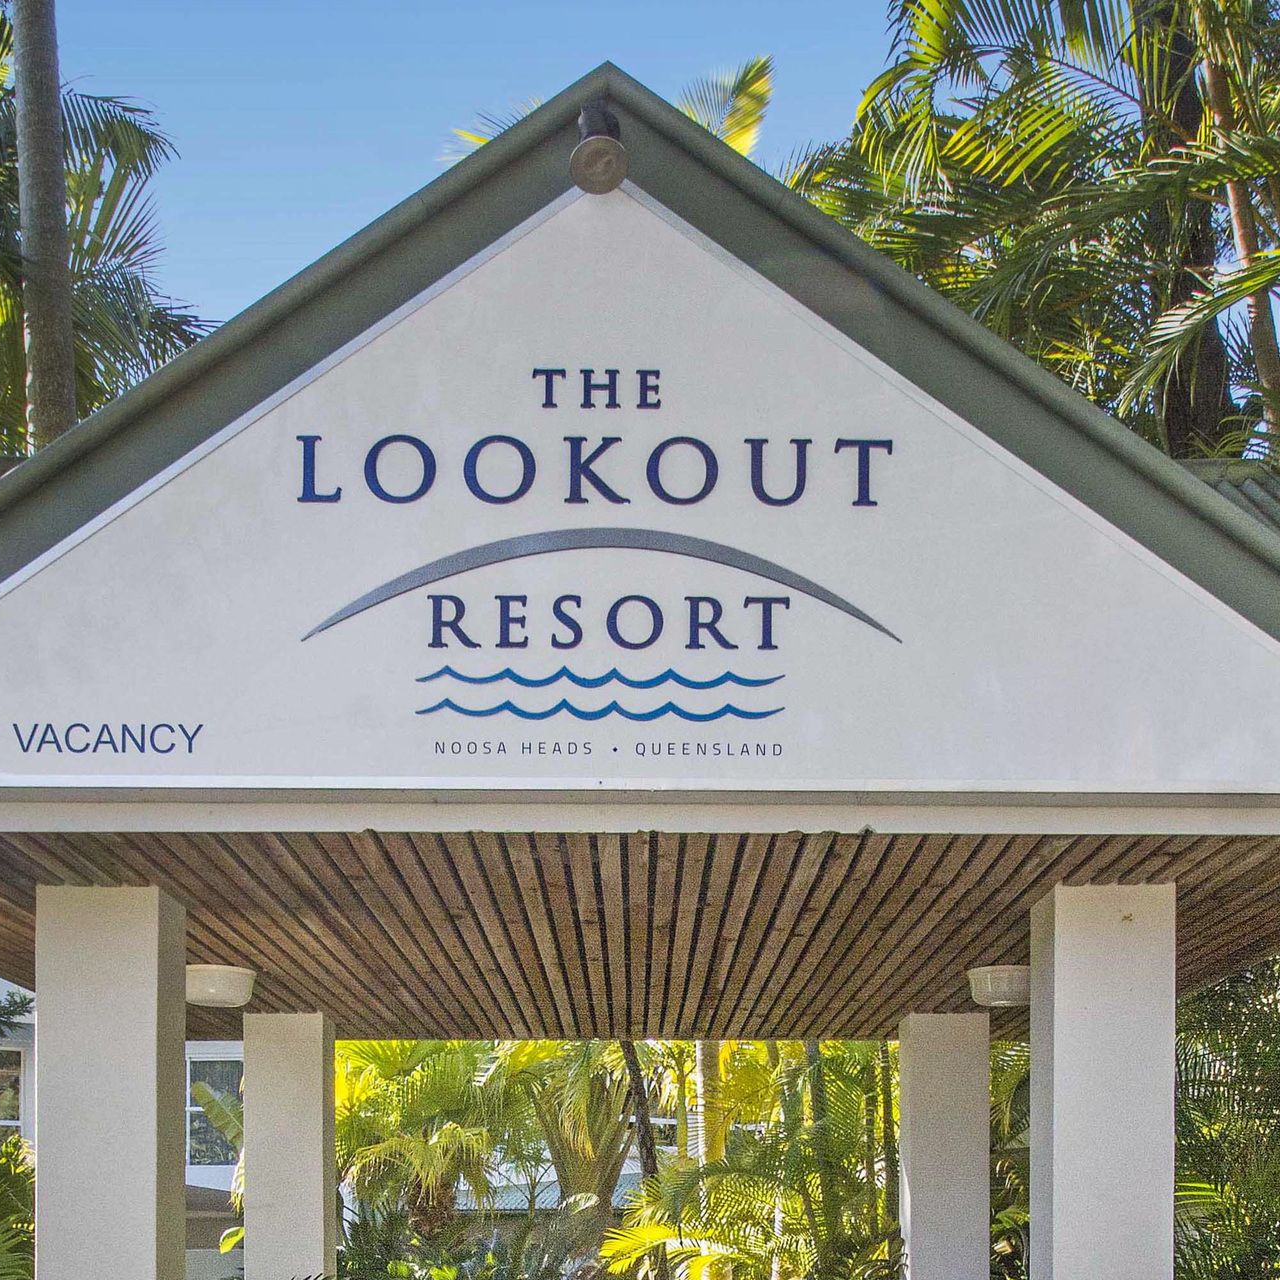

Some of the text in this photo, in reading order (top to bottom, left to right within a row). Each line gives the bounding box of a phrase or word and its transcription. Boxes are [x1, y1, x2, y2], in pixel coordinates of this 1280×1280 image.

[531, 367, 662, 410] THE
[295, 433, 894, 508] LOOKOUT
[426, 594, 792, 651] RESORT
[12, 722, 204, 754] VACANCY
[434, 741, 784, 758] NOOSA HEADS QUEENSLAND
